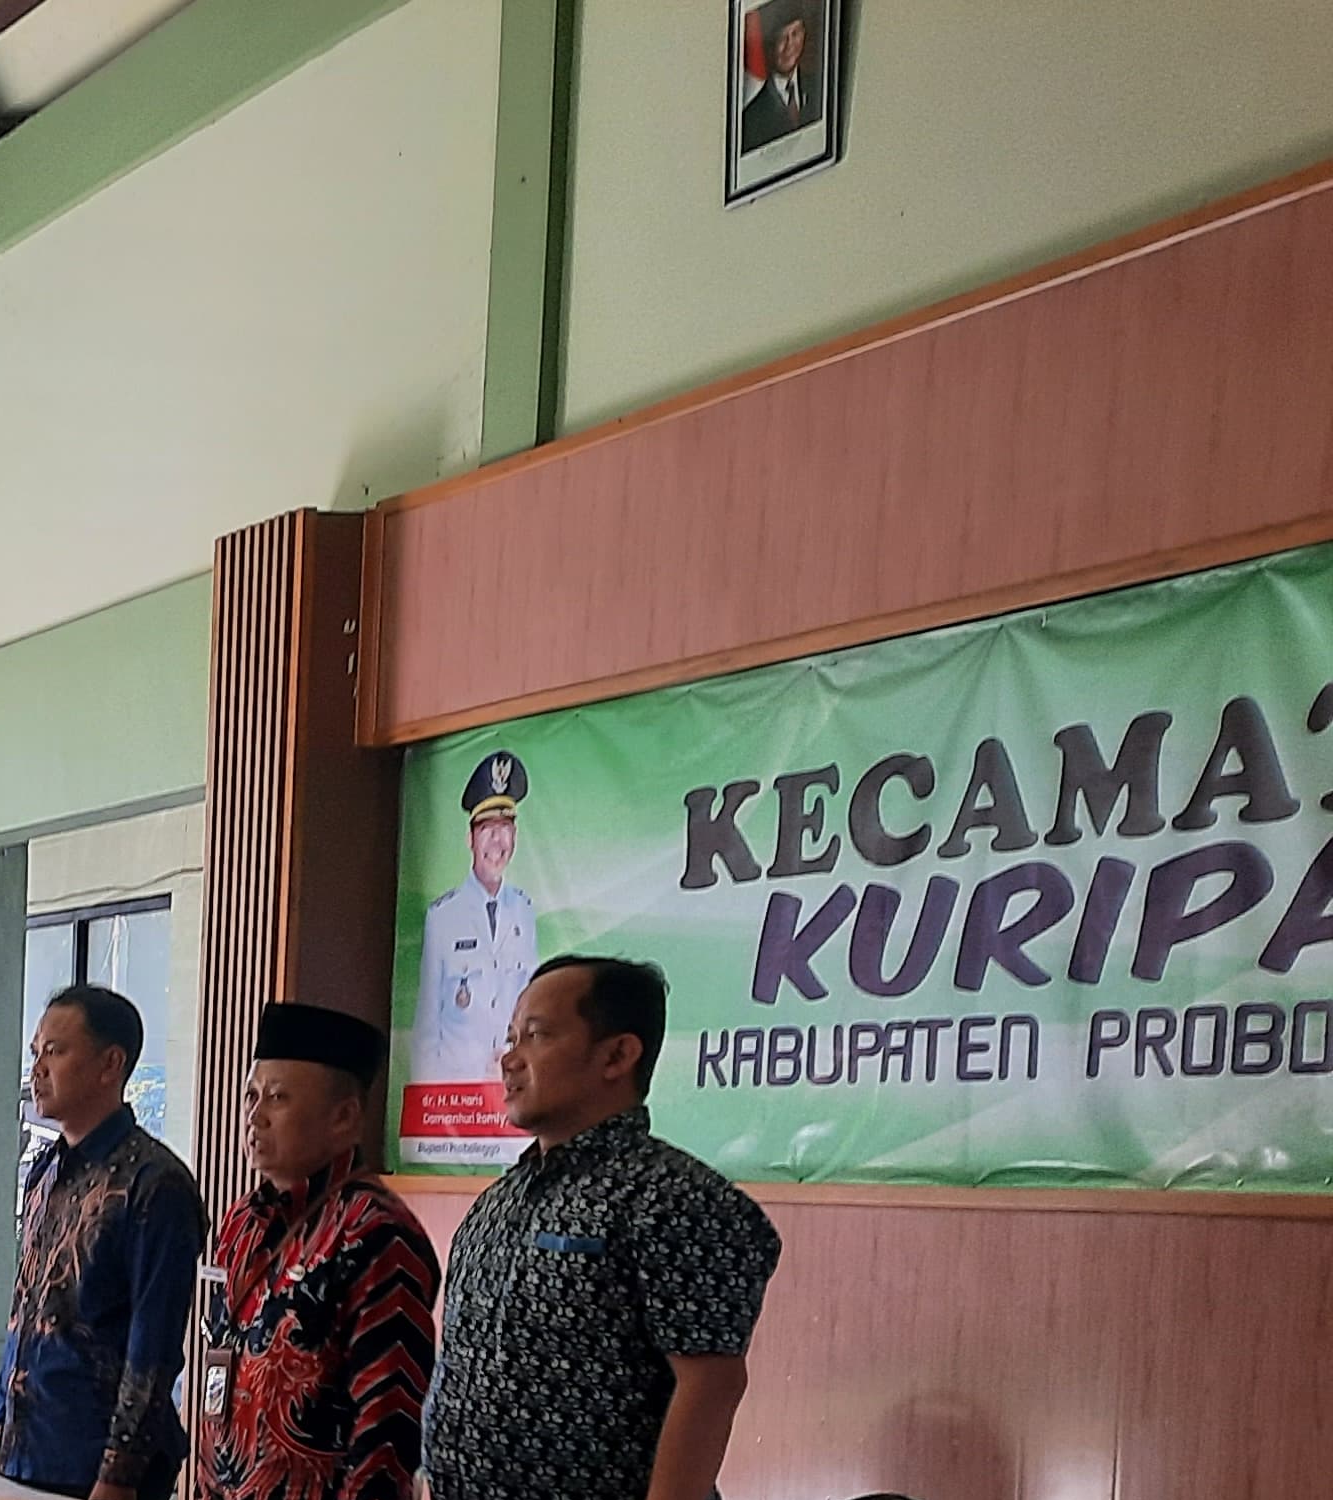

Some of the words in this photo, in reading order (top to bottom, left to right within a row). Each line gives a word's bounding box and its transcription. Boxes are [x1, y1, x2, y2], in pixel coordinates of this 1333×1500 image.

[680, 682, 1333, 890] KECAMA
[697, 1013, 1038, 1088] KABUPATEN
[1085, 1000, 1333, 1080] PROBO
